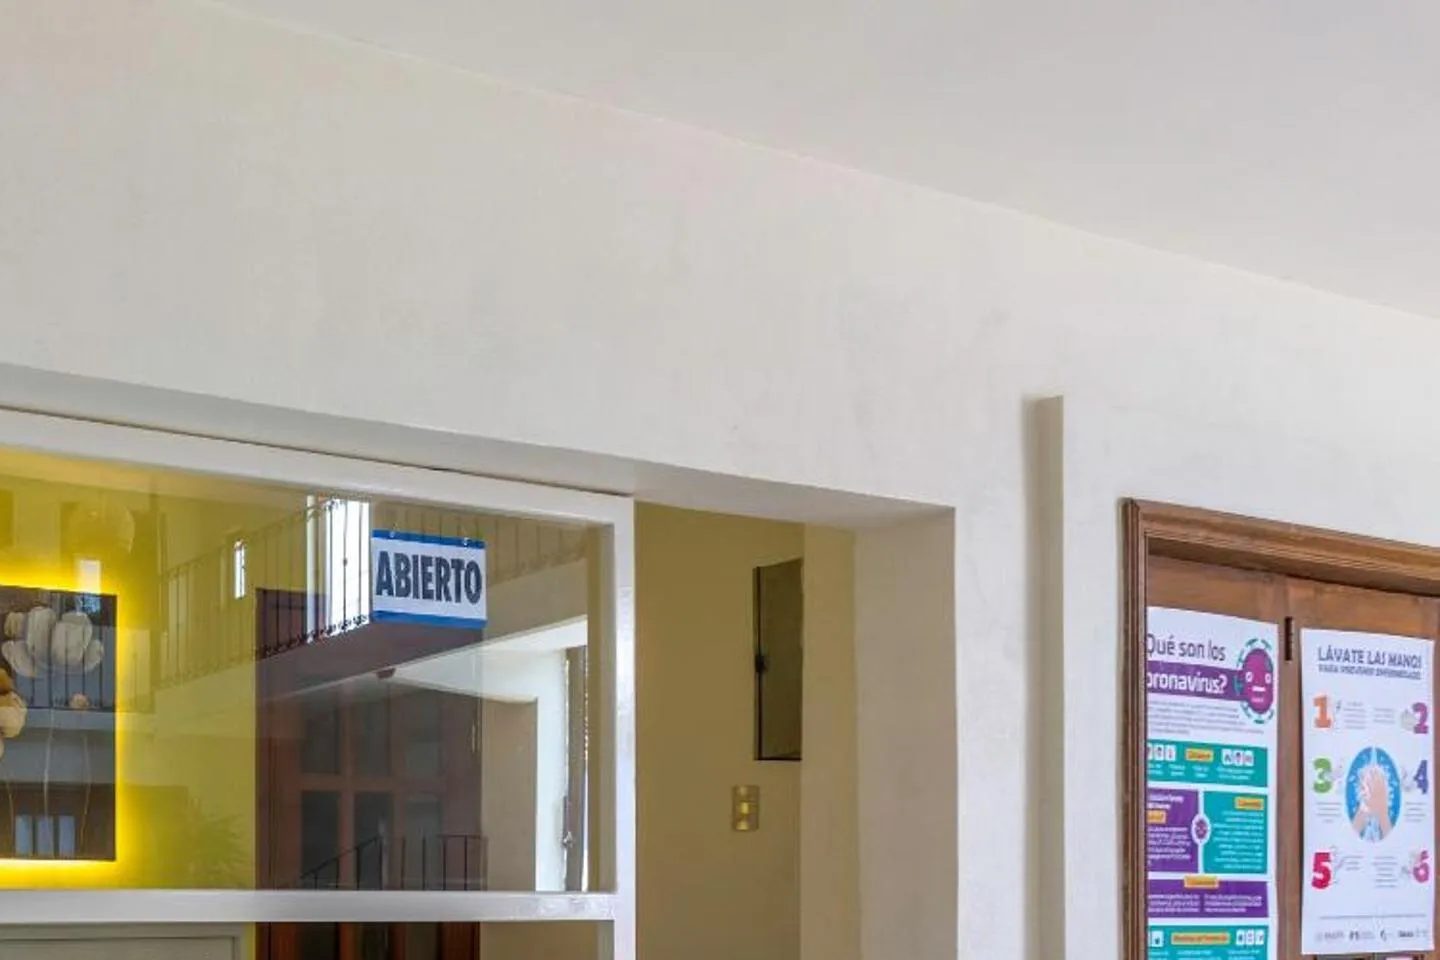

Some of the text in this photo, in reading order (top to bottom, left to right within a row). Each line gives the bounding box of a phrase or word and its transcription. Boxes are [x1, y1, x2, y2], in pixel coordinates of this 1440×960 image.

[375, 550, 483, 605] ABIERTO
[1178, 641, 1206, 659] son
[1208, 639, 1227, 661] los
[1318, 644, 1365, 664] LÁVATE
[1147, 671, 1228, 694] oronavirus?
[1313, 694, 1331, 729] 1
[1411, 702, 1429, 735] 2
[1313, 757, 1332, 794] 3
[1413, 759, 1429, 795] 4
[1311, 851, 1332, 889] 5
[1412, 849, 1429, 883] 6
